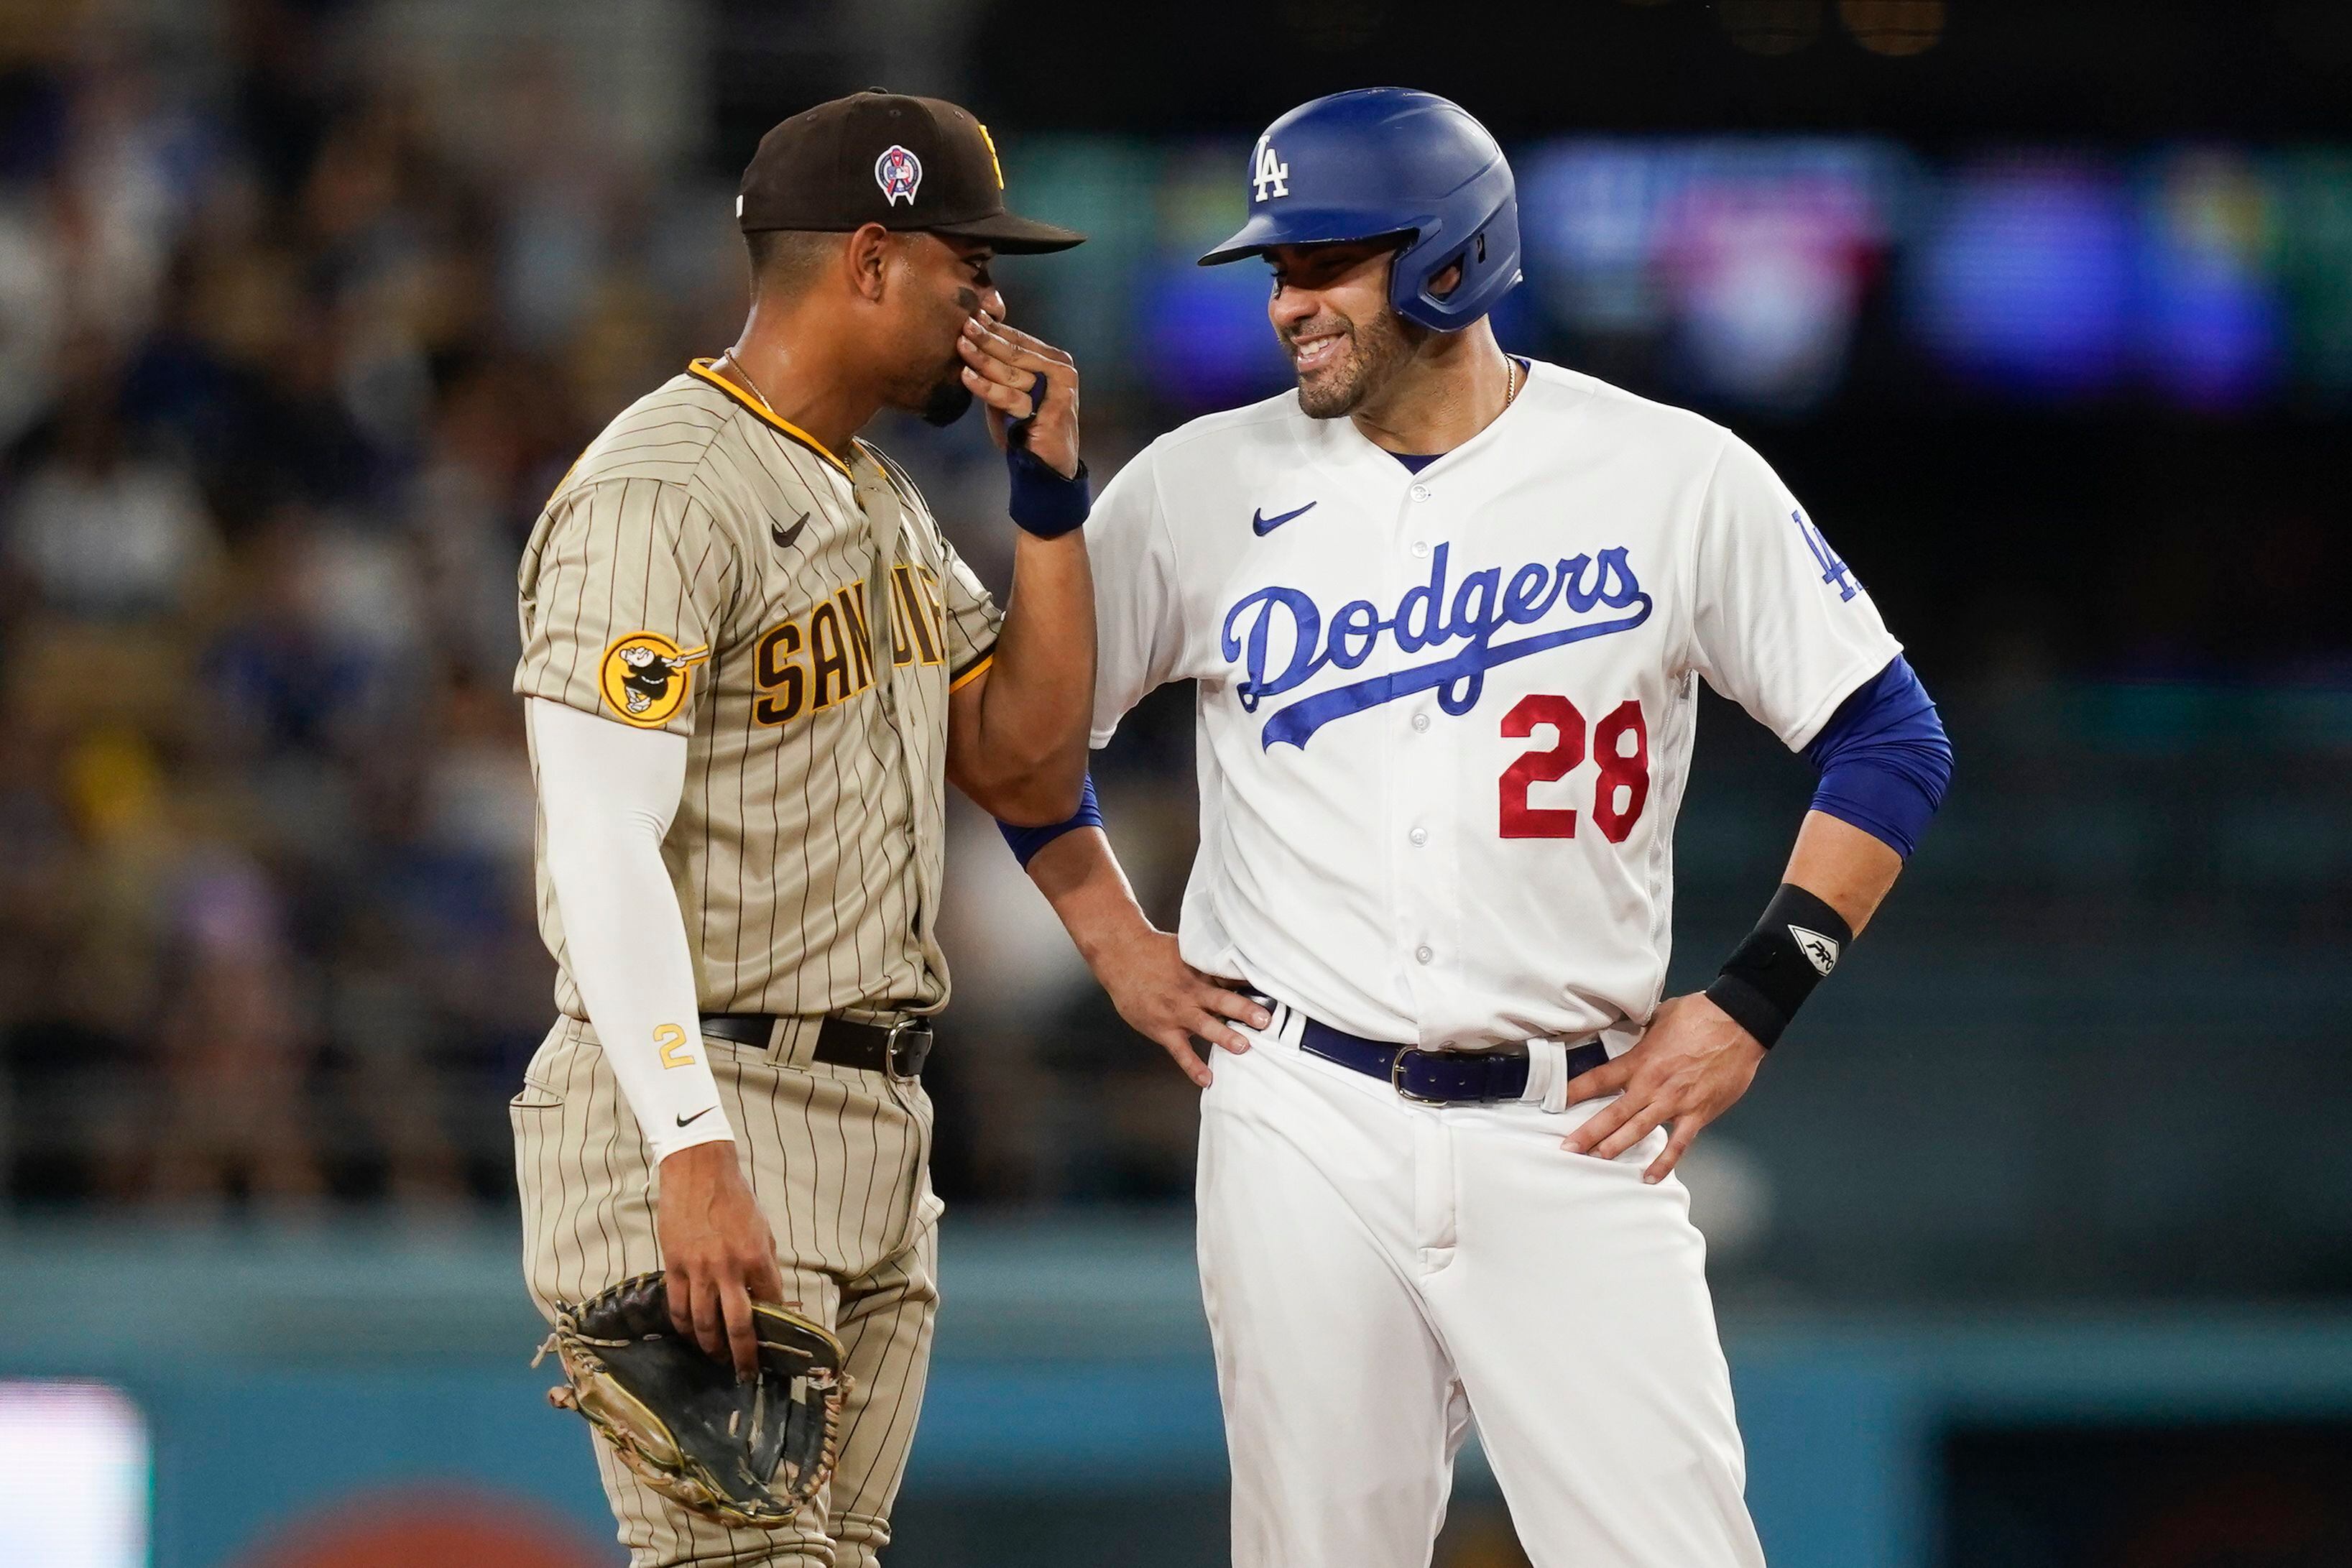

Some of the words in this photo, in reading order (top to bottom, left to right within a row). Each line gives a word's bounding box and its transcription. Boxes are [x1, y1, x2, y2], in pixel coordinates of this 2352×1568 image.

[1253, 134, 1289, 203] LA
[756, 578, 877, 727] SAN
[1221, 541, 1652, 716] Dodgers
[1499, 694, 1650, 844] 28
[652, 1023, 696, 1069] 2
